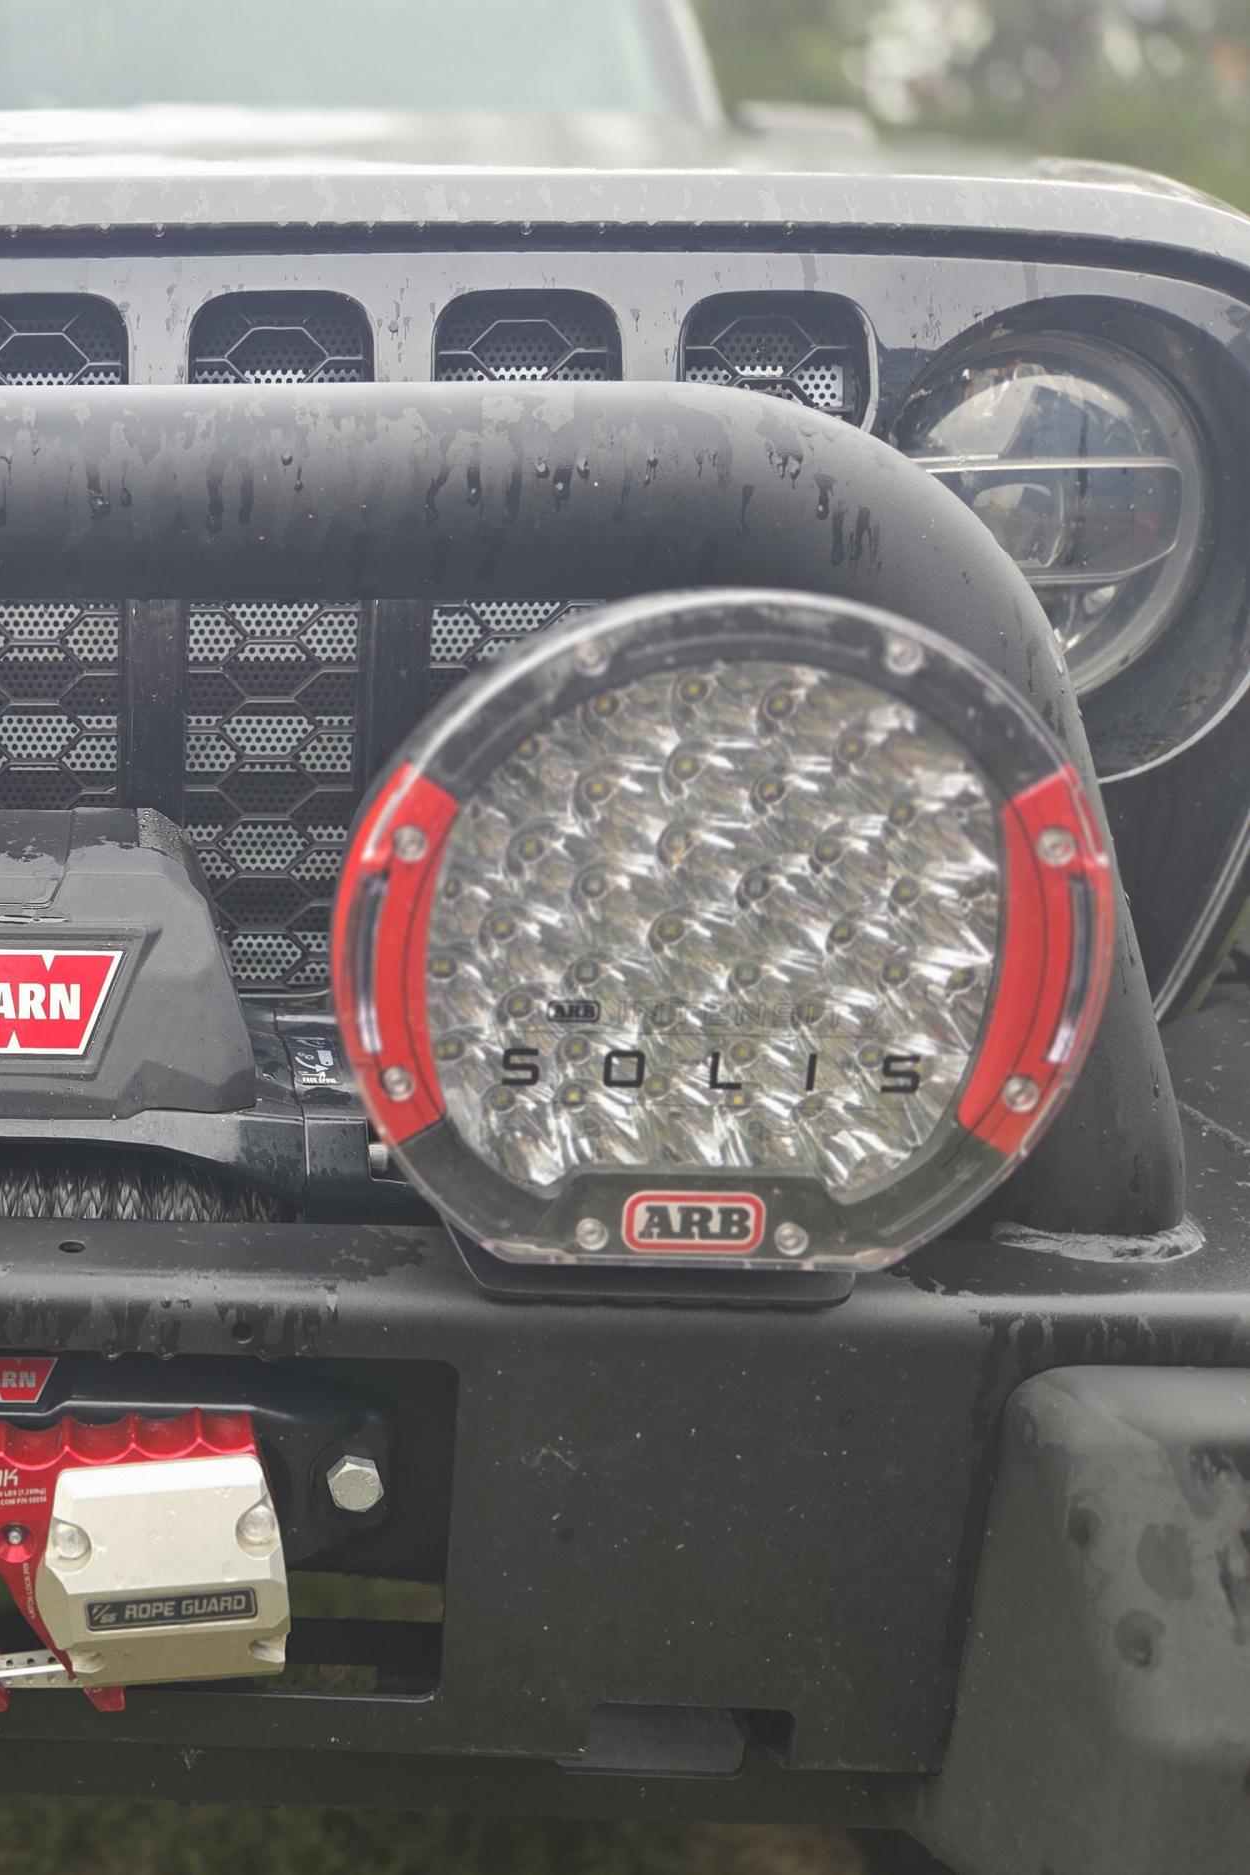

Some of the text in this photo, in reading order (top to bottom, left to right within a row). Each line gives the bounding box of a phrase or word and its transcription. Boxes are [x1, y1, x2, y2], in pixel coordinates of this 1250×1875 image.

[553, 1002, 597, 1021] ARB
[501, 1048, 922, 1093] SOLIS
[638, 1205, 751, 1240] ARB
[124, 1601, 176, 1620] ROPE
[181, 1595, 246, 1616] GUARD
